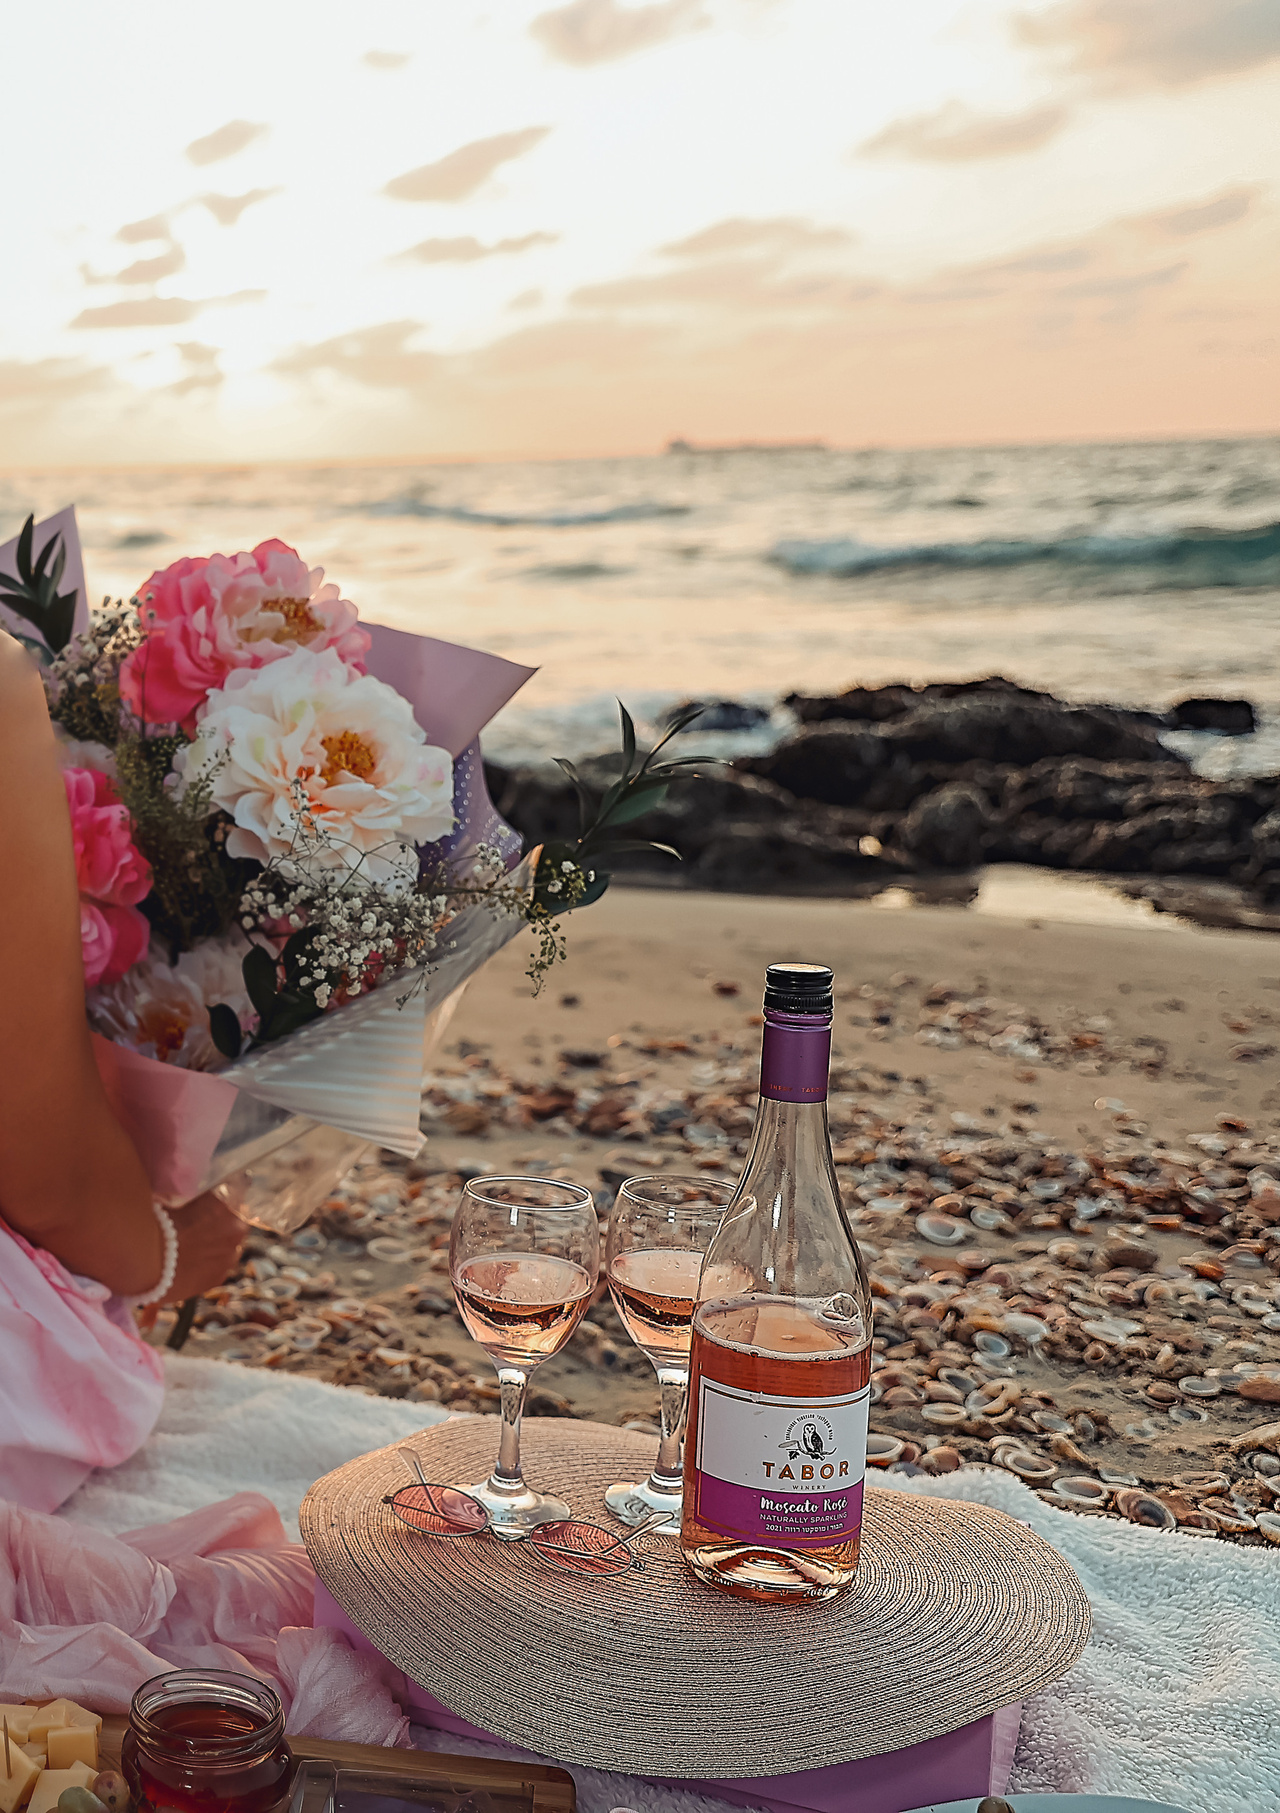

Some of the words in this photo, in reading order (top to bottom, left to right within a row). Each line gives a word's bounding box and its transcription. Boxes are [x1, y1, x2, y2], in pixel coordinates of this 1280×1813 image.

[762, 1460, 849, 1480] TABOR
[760, 1496, 819, 1514] Moscato
[823, 1496, 848, 1512] Rosé
[759, 1513, 809, 1523] NATURALLY
[810, 1511, 848, 1523] SPARKLING
[765, 1523, 782, 1532] 2021
